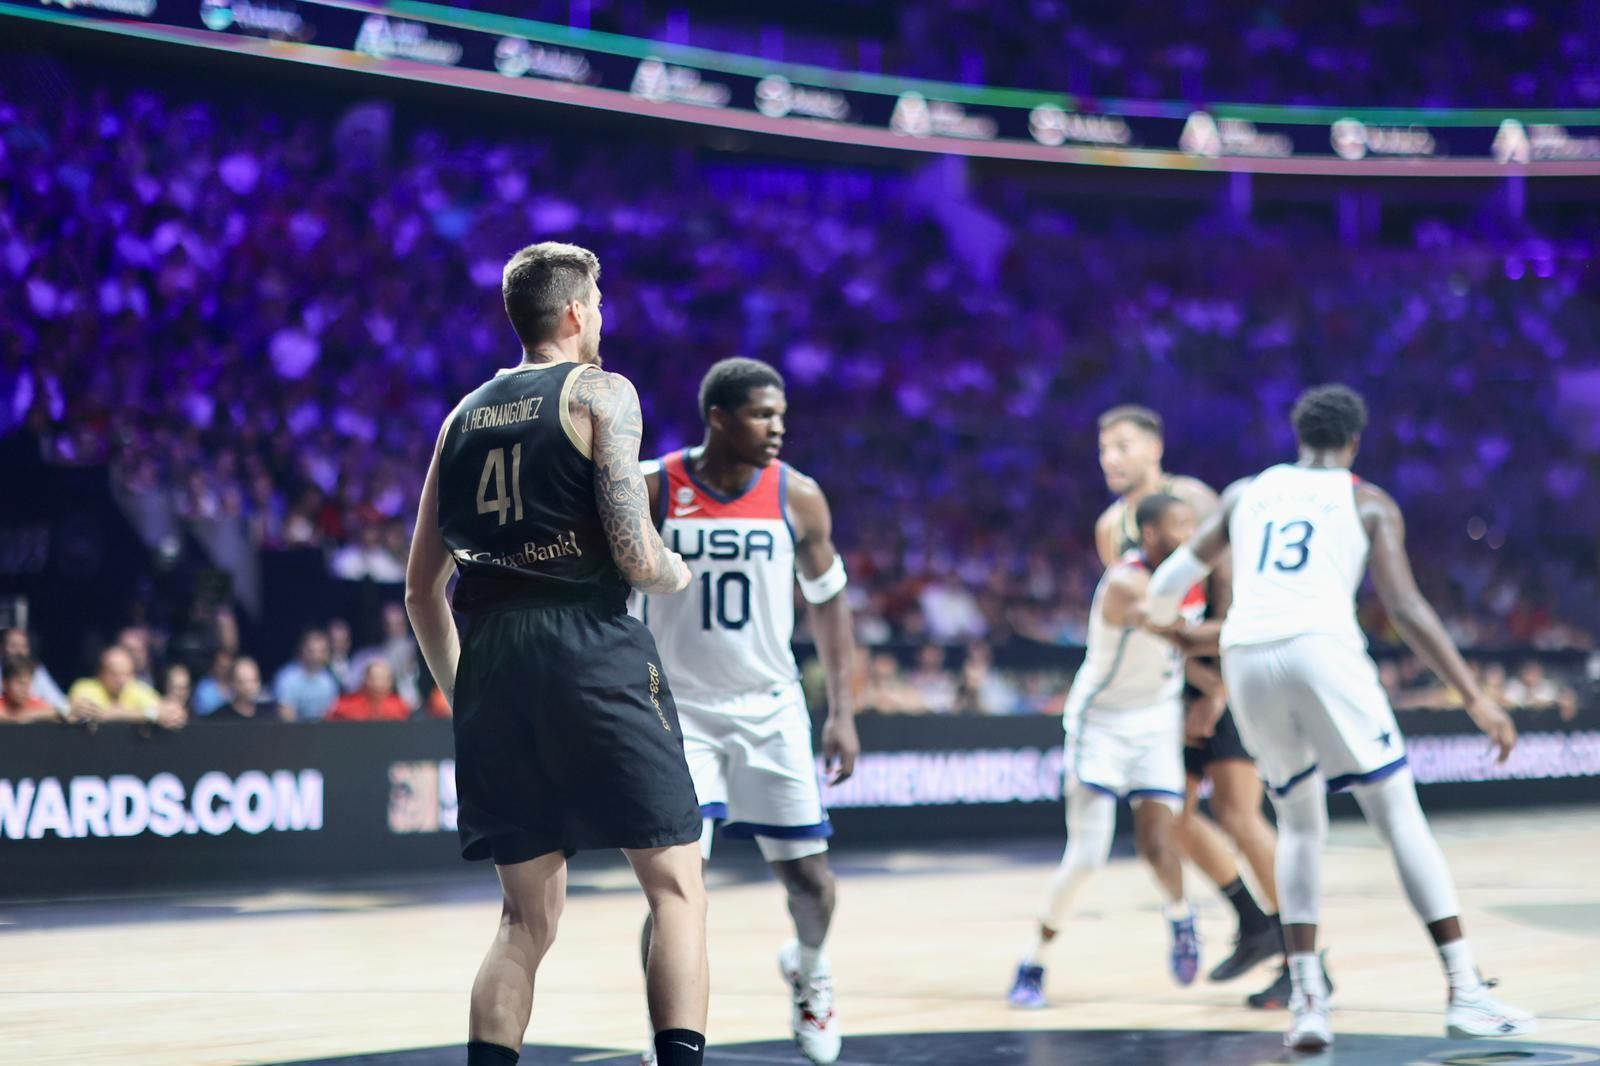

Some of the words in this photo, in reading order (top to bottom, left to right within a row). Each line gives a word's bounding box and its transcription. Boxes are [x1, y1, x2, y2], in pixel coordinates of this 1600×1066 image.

[476, 443, 524, 526] 41
[671, 529, 774, 561] USA
[1257, 520, 1314, 572] 13
[701, 571, 751, 630] 10
